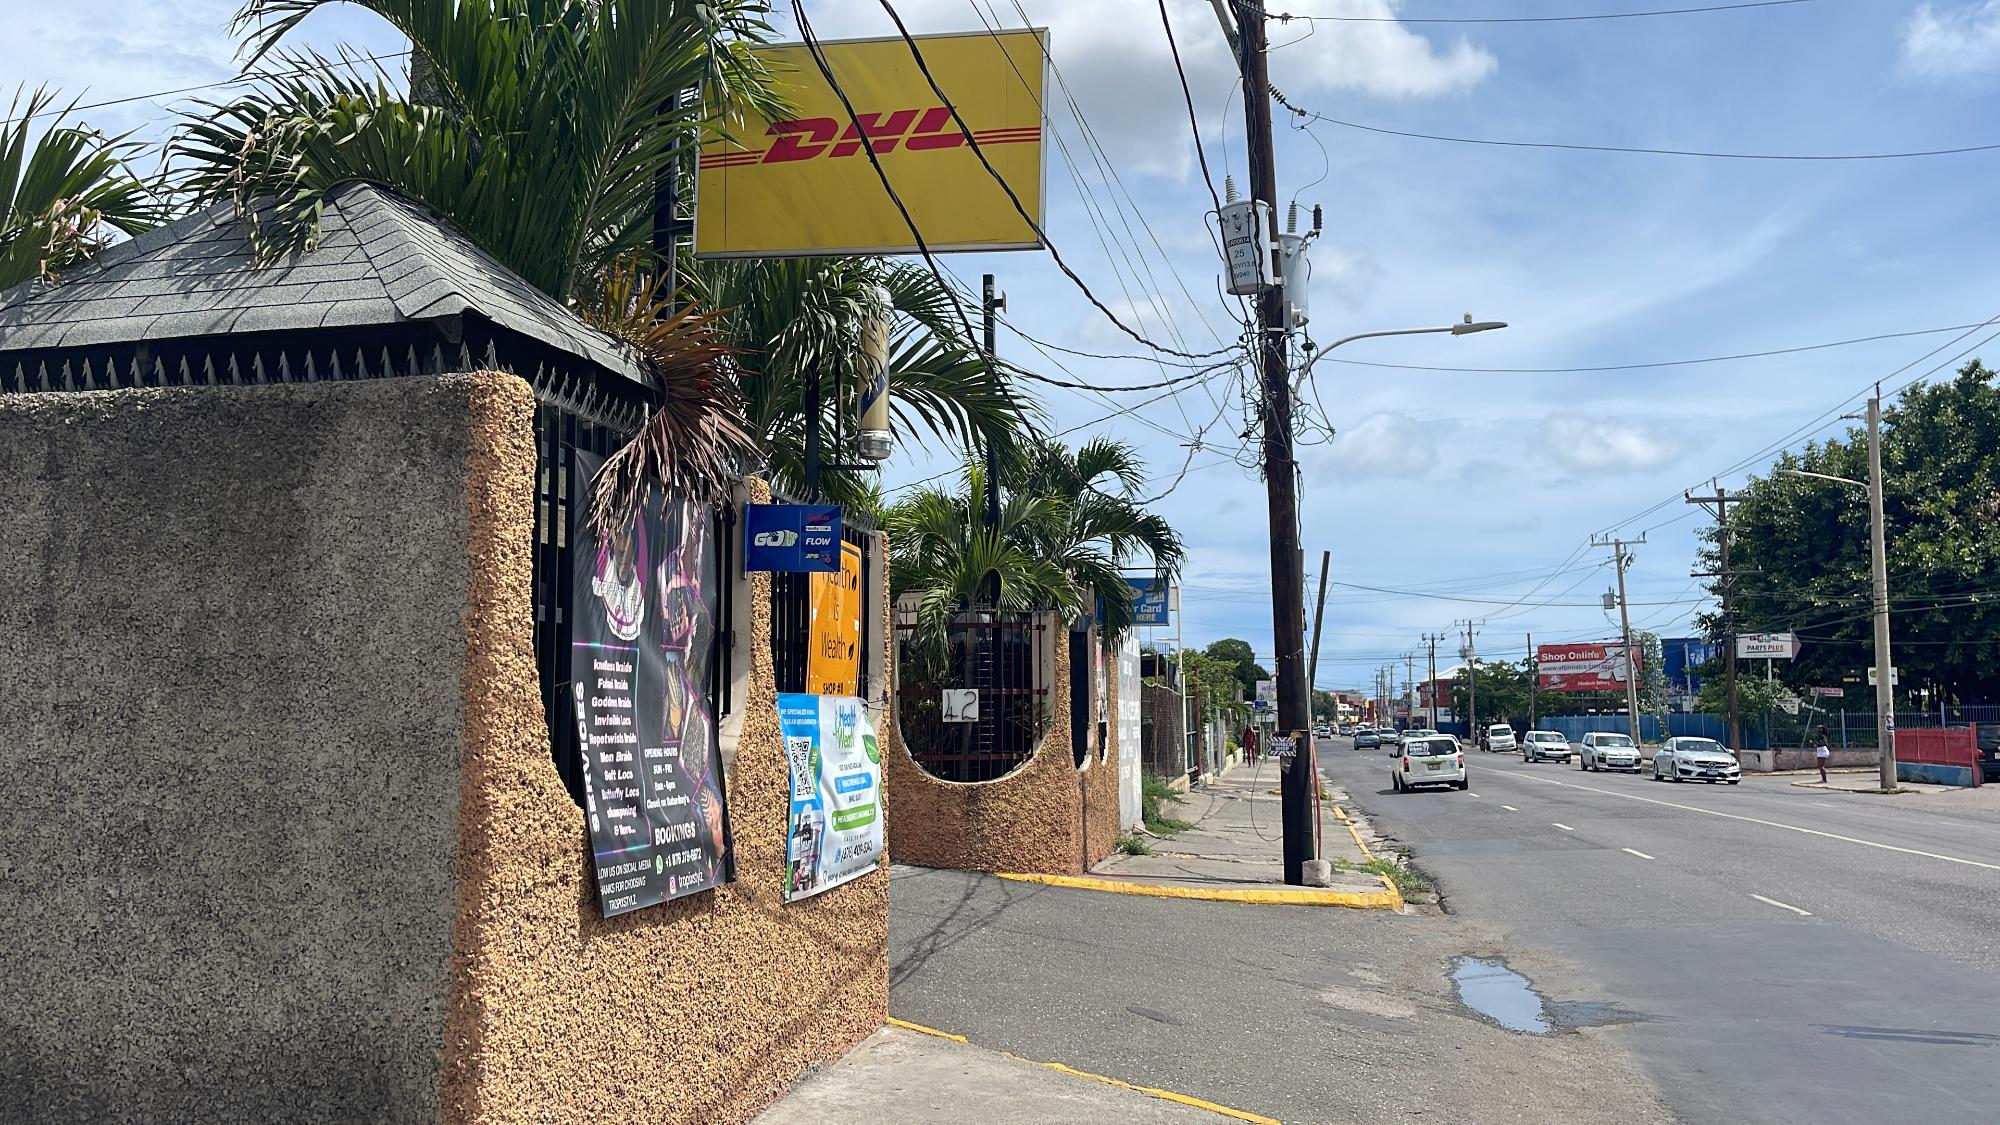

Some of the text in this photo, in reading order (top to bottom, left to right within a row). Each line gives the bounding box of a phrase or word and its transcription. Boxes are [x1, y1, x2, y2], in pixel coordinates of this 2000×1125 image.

[761, 105, 967, 163] DHL
[1234, 248, 1245, 259] 25
[754, 530, 785, 546] GO
[805, 537, 832, 546] FLOW
[833, 596, 840, 622] is
[1140, 603, 1162, 613] Card
[1136, 613, 1156, 621] HERE
[821, 631, 847, 660] Wealth
[1541, 651, 1600, 661] Shop Online
[615, 661, 632, 673] Braids
[614, 678, 629, 690] Braids
[823, 682, 836, 695] SHOP
[591, 695, 632, 708] Goddess Braids
[575, 681, 600, 833] SERVICES
[600, 751, 614, 763] Men
[644, 747, 678, 758] OPENING HOURS
[810, 751, 818, 764] ME
[604, 769, 633, 781] Soft Locs
[601, 787, 640, 801] Butterfly Locs
[614, 824, 620, 836] &
[654, 821, 696, 846] BOOKINGS
[608, 864, 616, 877] US
[615, 863, 623, 876] ON
[623, 862, 637, 875] SOCIAL
[638, 858, 652, 871] MEDIA
[615, 880, 624, 892] FOR
[624, 875, 646, 891] CHOOSING
